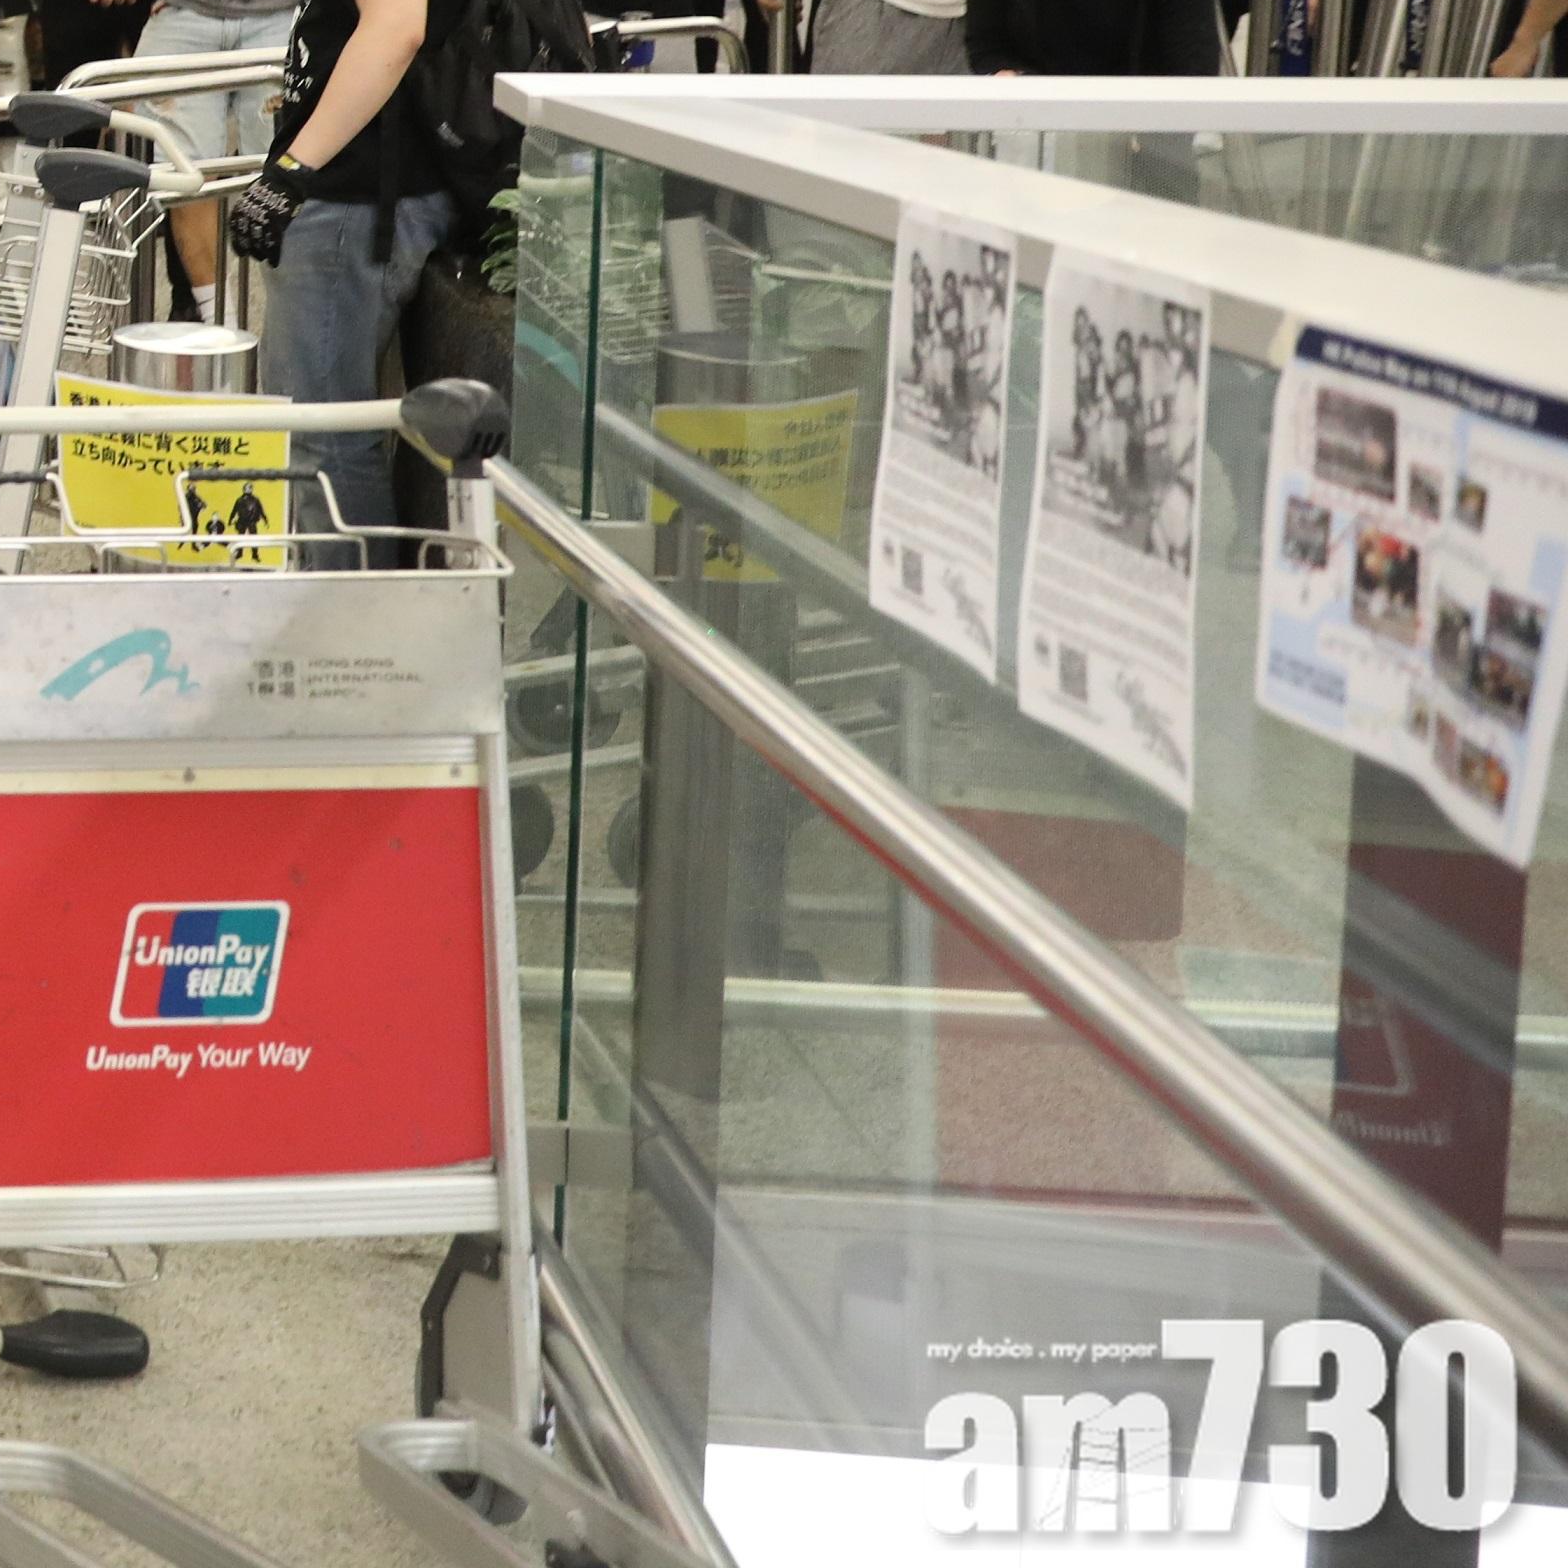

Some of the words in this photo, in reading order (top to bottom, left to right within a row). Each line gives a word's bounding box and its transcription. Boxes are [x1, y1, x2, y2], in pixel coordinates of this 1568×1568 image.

[134, 934, 270, 976] UnionPay
[85, 1044, 193, 1079] UnionPay
[196, 1043, 252, 1069] Your
[258, 1042, 312, 1073] Way
